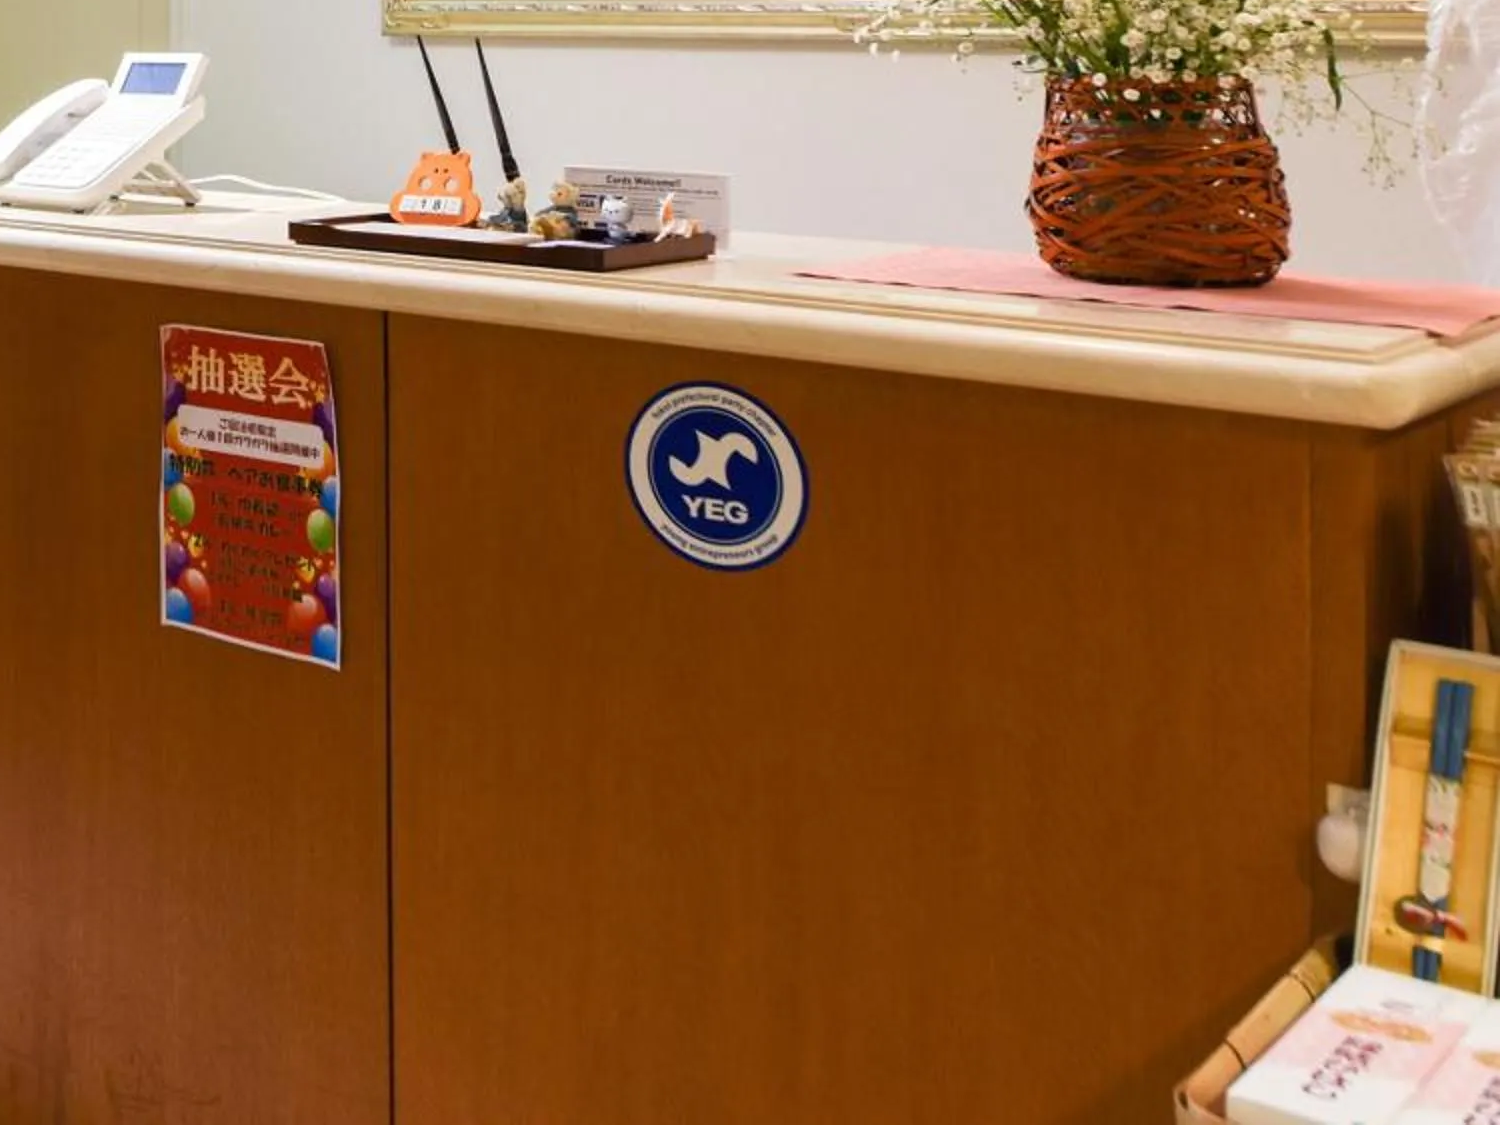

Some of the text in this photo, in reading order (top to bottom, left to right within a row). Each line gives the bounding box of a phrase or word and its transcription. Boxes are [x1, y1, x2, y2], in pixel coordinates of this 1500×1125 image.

[186, 344, 311, 410] 抽選会
[681, 493, 750, 525] YEG
